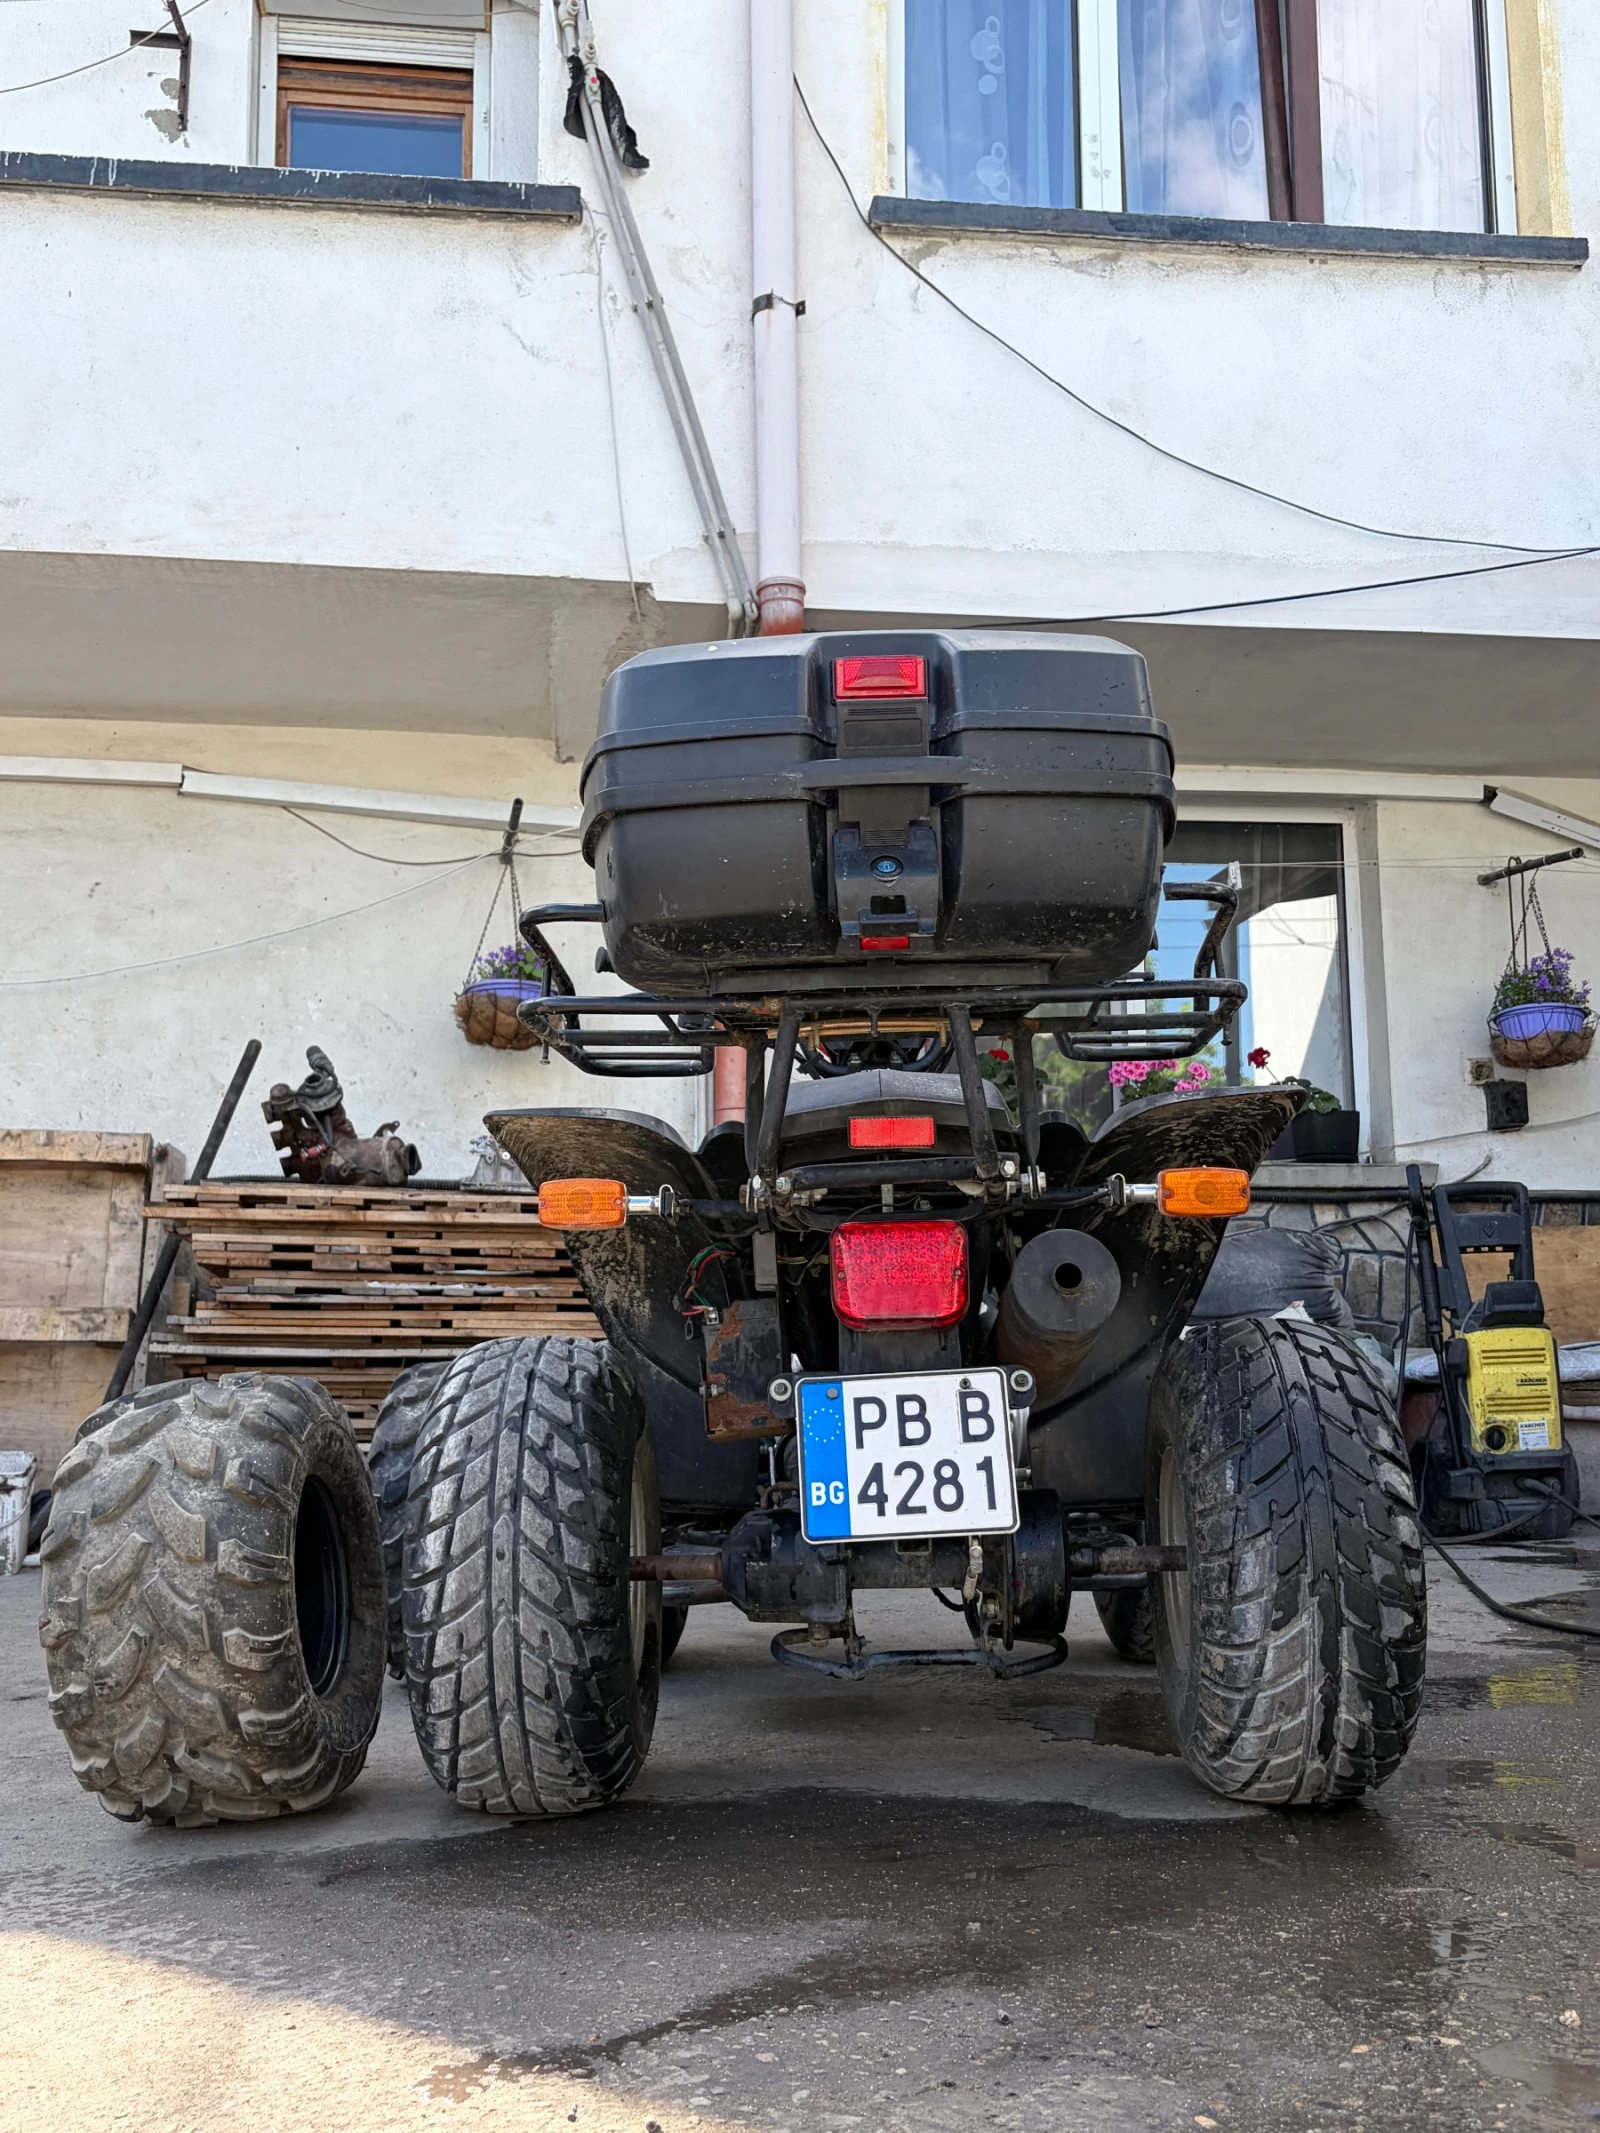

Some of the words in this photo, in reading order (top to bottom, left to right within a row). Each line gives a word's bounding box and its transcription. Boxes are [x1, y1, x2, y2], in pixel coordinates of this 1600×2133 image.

[958, 1390, 995, 1443] B
[811, 1481, 844, 1506] BG
[857, 1456, 997, 1517] 4281
